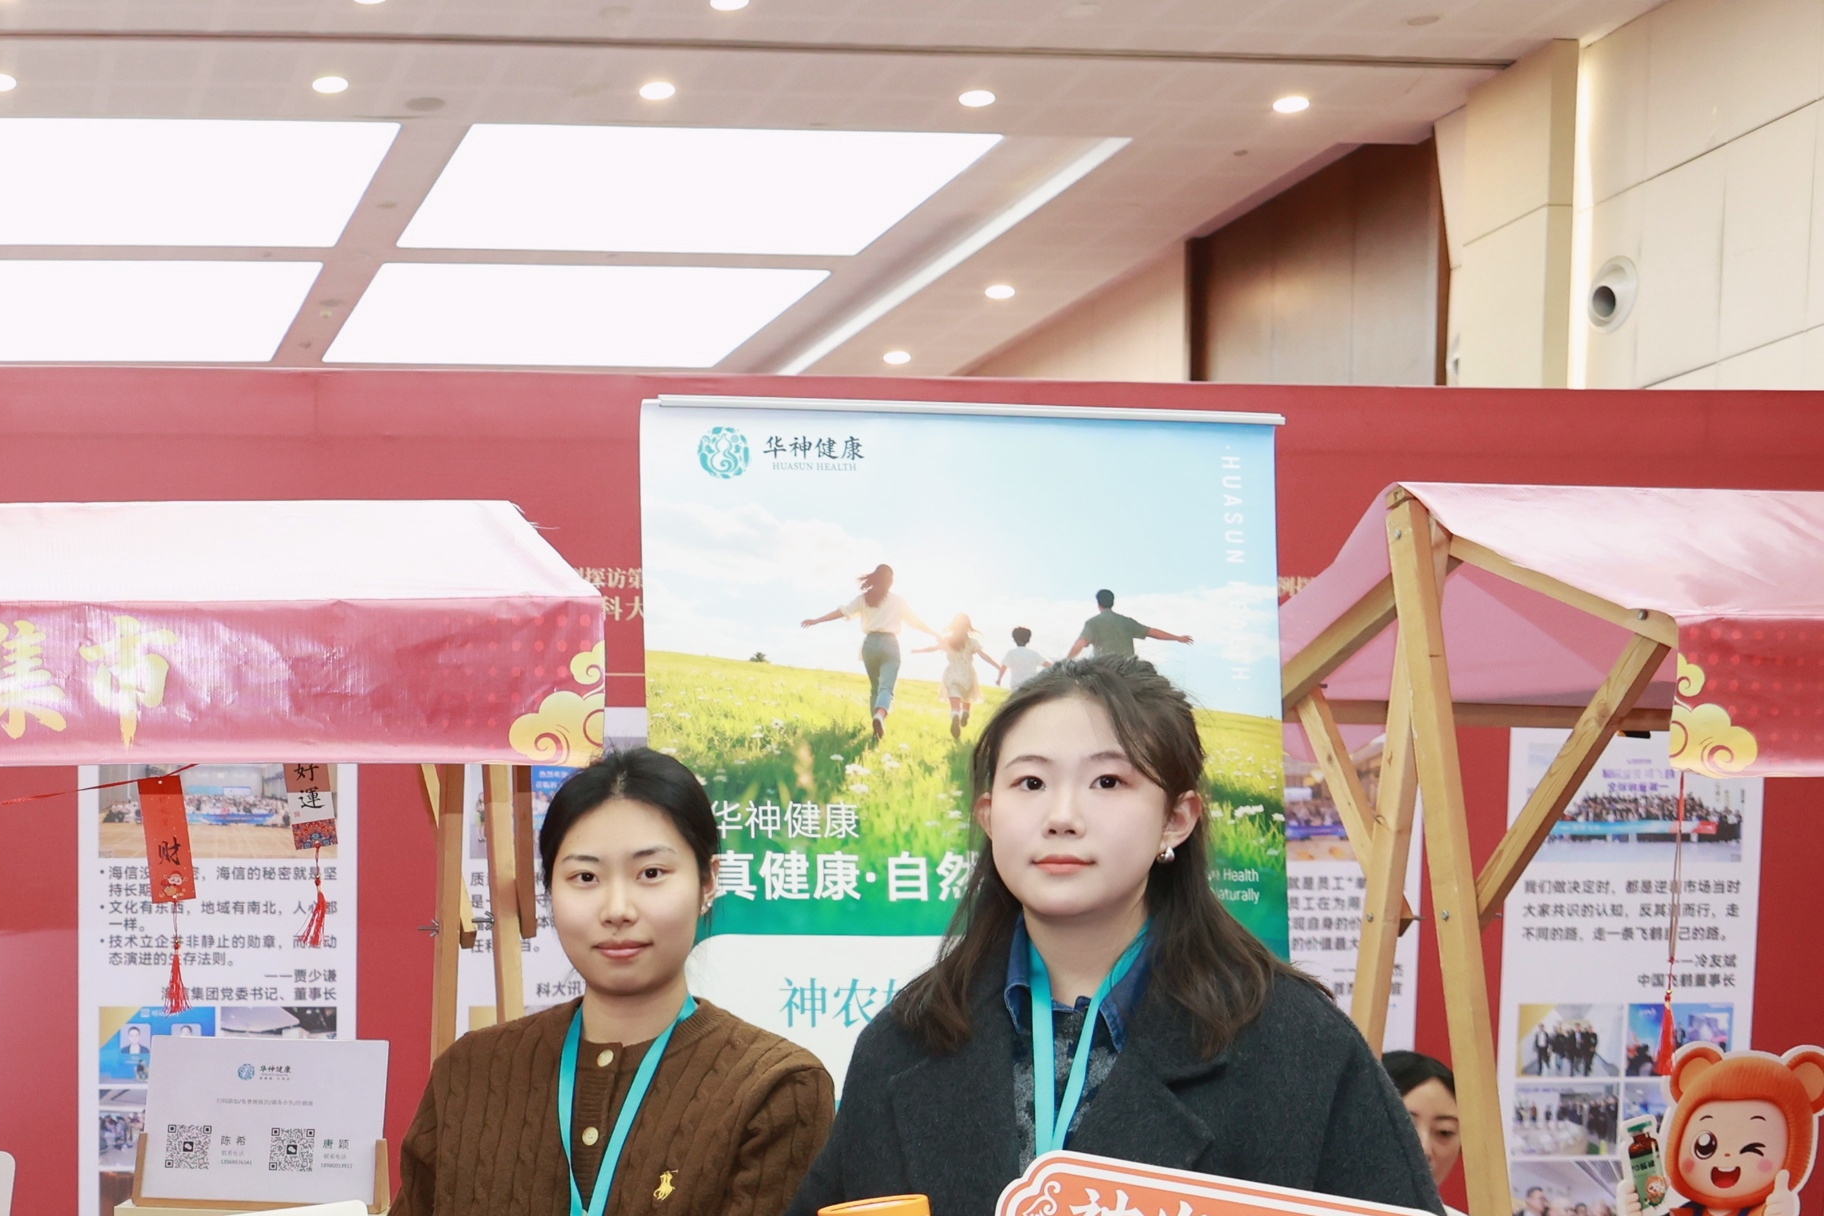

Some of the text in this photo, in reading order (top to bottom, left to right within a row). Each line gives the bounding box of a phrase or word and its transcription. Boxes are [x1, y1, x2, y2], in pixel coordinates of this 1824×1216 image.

[763, 435, 866, 461] 华神健康
[772, 462, 857, 472] HUASUN HEALTH
[711, 800, 861, 840] 华神健康
[1222, 868, 1260, 882] Health
[108, 917, 146, 933] 一样。
